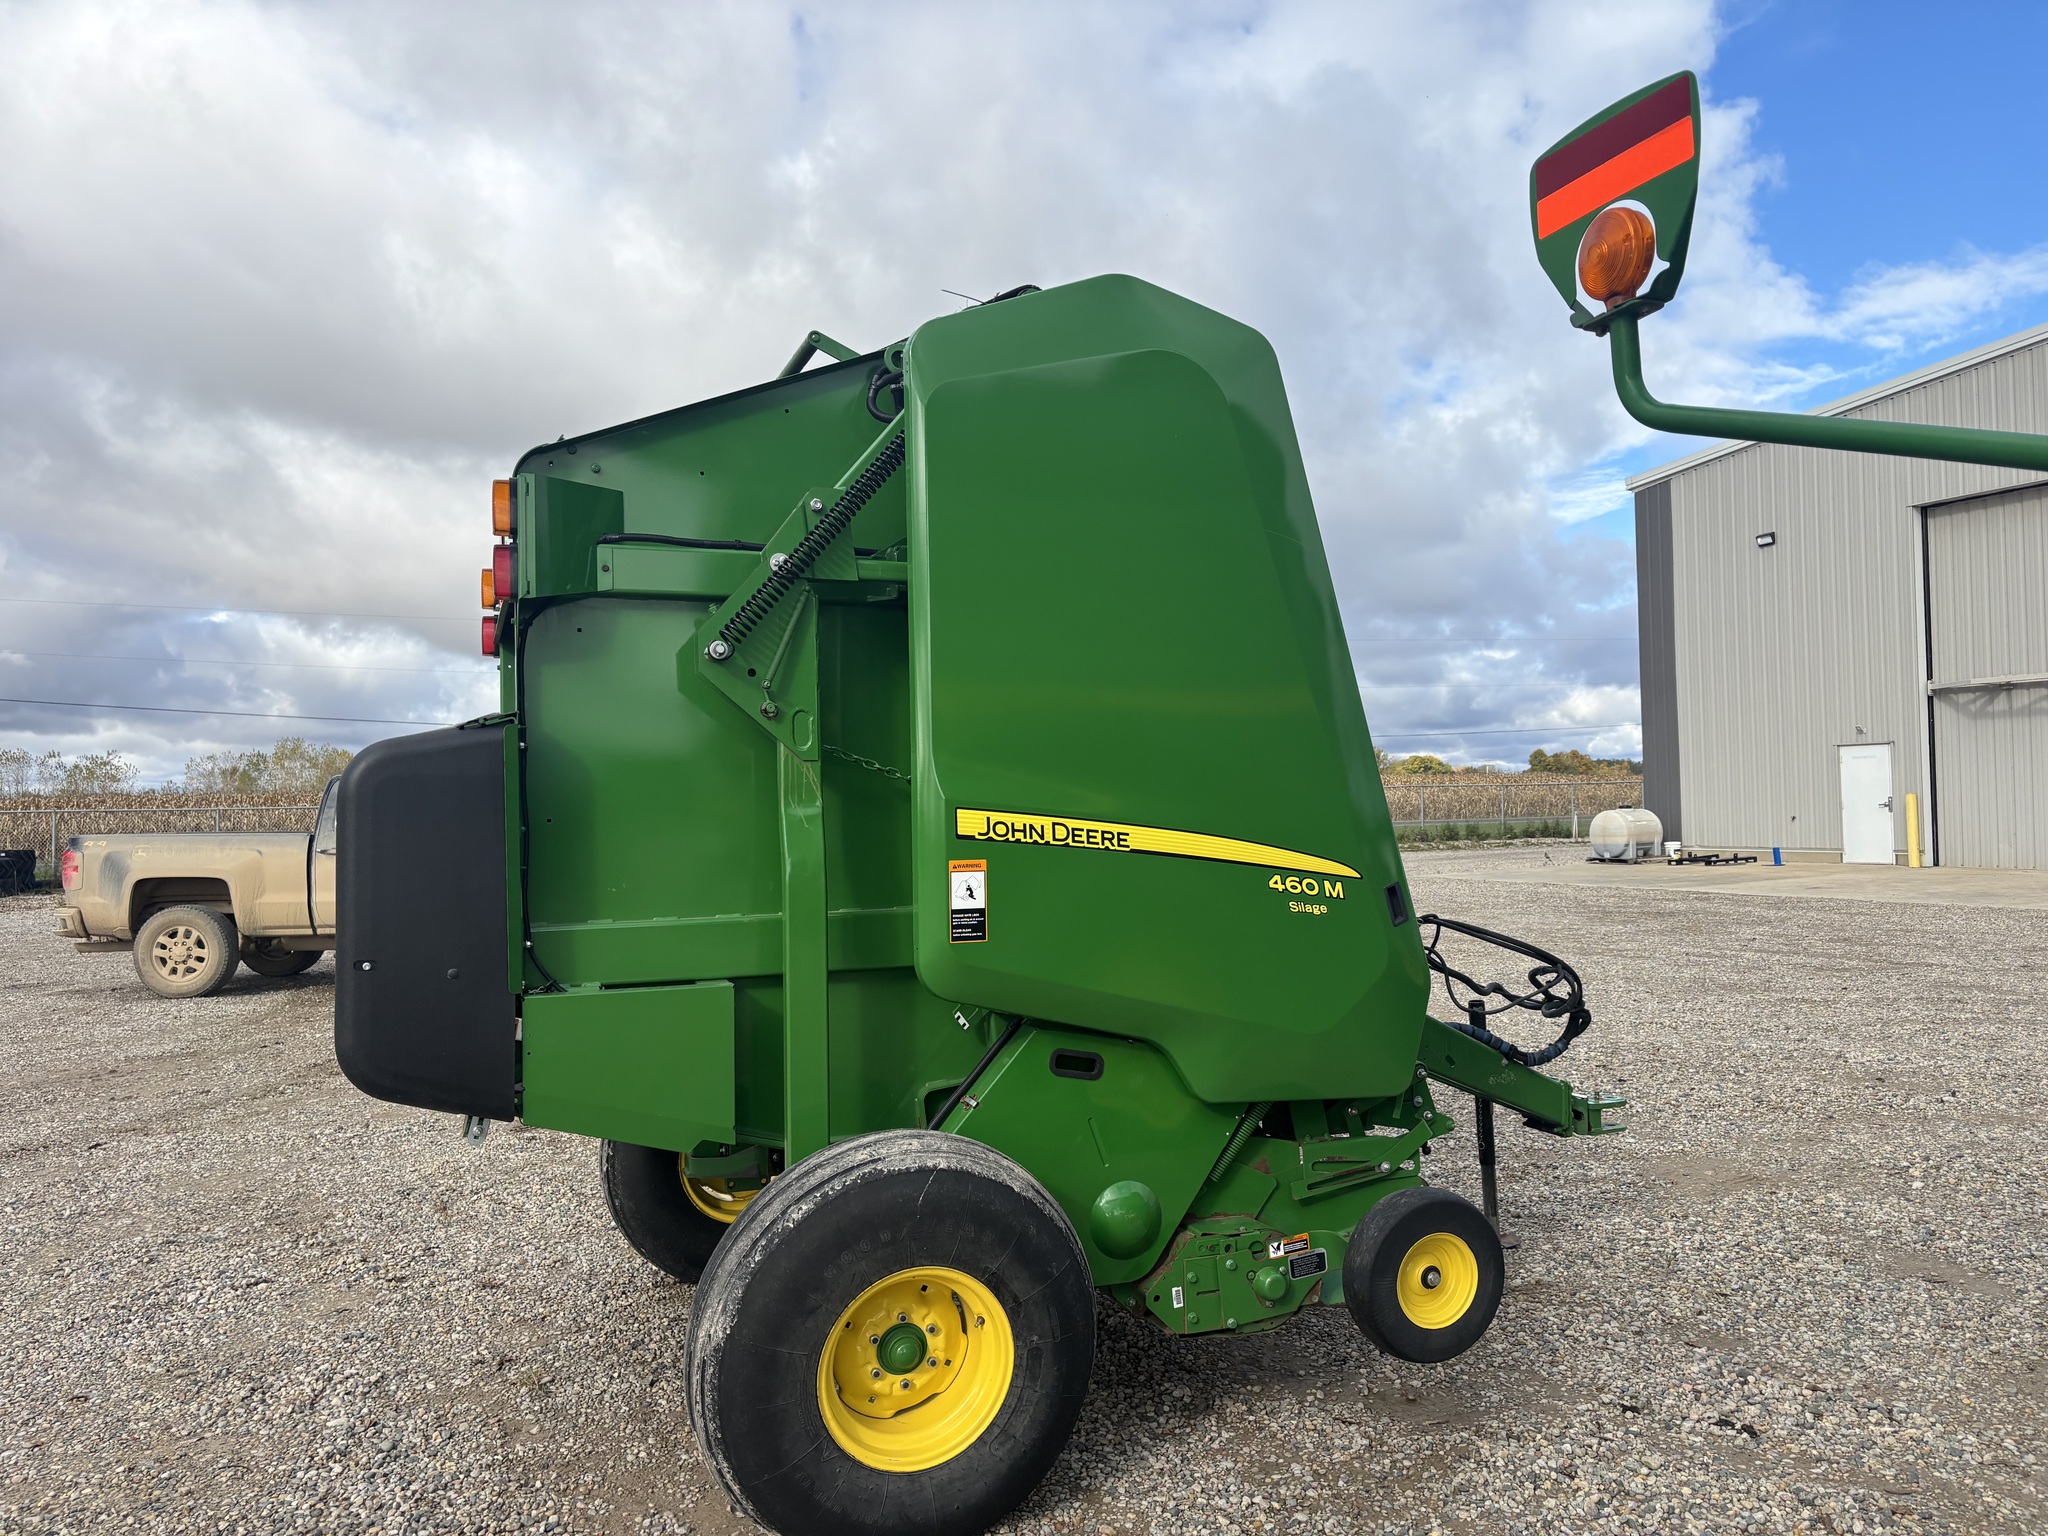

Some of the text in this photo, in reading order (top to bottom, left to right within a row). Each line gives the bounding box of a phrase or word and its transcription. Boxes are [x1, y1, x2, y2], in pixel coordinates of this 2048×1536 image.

[977, 816, 1131, 849] JOHN DEERE
[1268, 874, 1345, 899] 460 M
[1288, 901, 1328, 915] Silage
[824, 1219, 996, 1278] GOODYEAR
